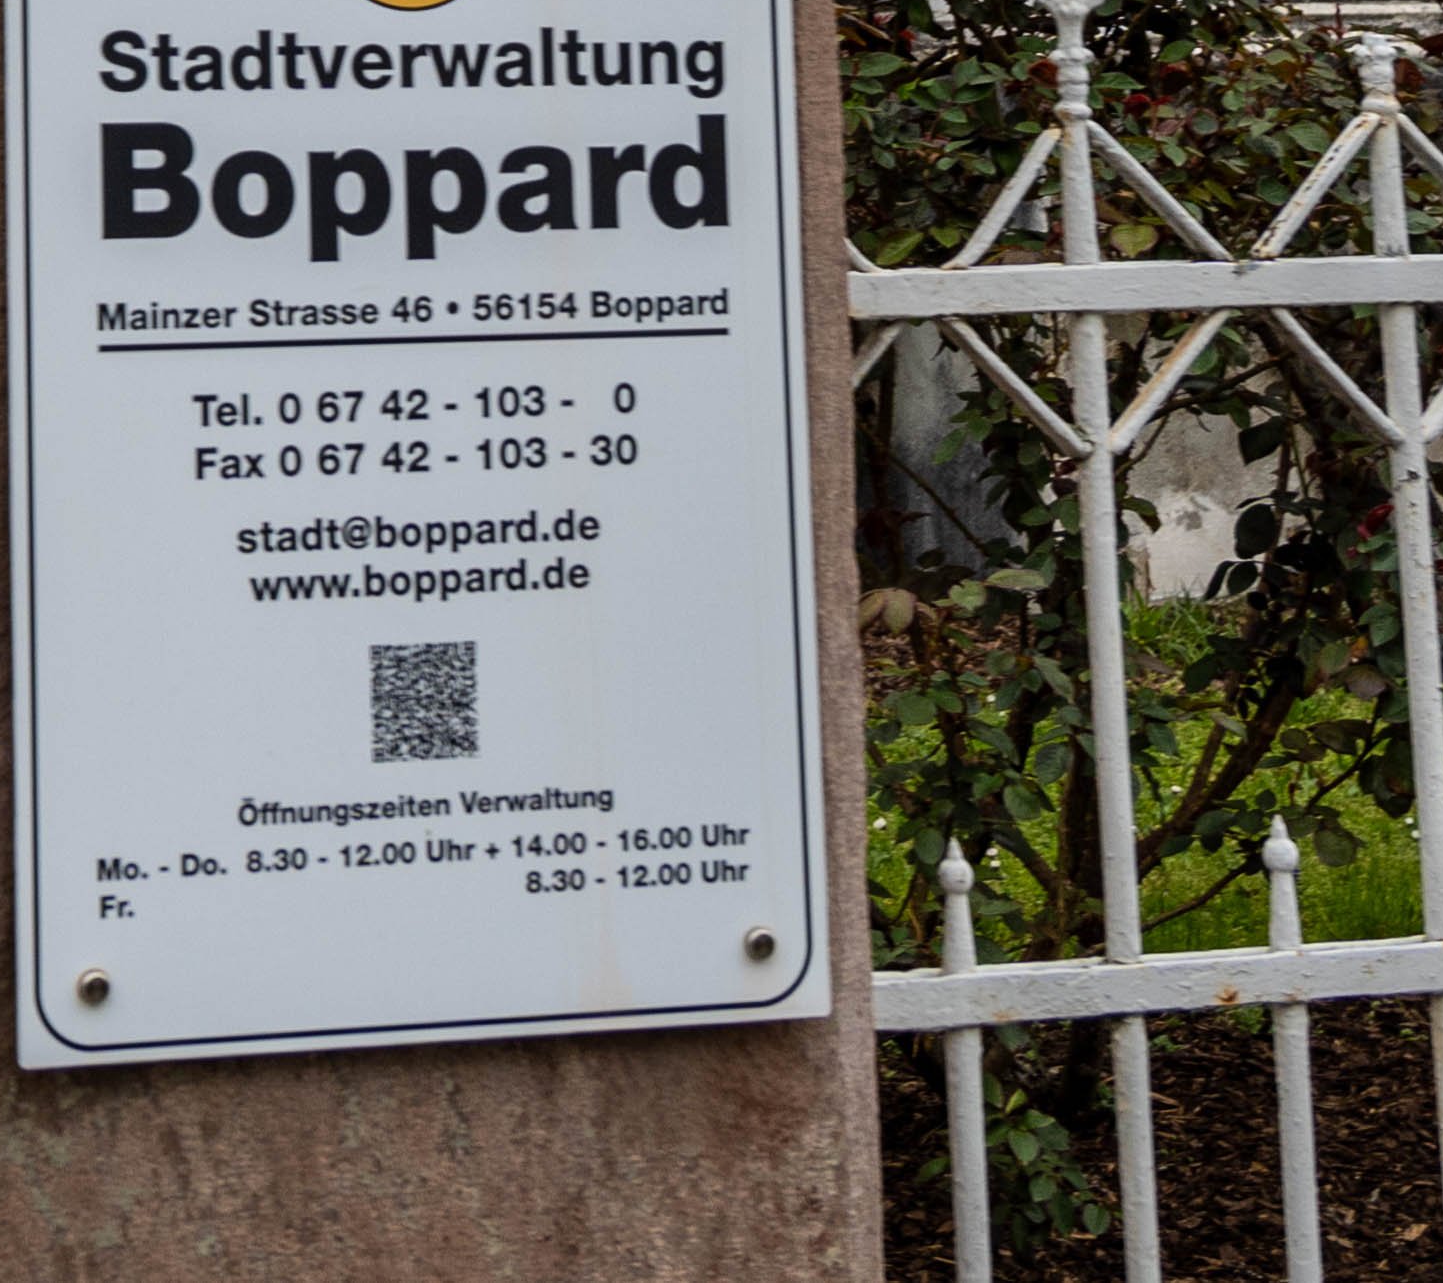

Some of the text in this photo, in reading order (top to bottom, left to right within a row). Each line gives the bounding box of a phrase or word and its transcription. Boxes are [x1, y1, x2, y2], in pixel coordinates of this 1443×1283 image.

[99, 26, 725, 99] Stadtverwaltung
[100, 113, 730, 263] Boppard
[98, 302, 237, 331] Mainzer
[249, 298, 379, 328] Strasse
[391, 295, 433, 323] 46
[473, 292, 578, 322] 56154
[591, 287, 729, 323] Boppard
[192, 393, 262, 427] Tel.
[278, 392, 302, 425] 0
[317, 390, 364, 424] 67
[381, 388, 429, 421] 42
[475, 385, 546, 418] 103
[614, 382, 636, 414] 0
[196, 447, 265, 480] Fax
[279, 444, 302, 477] 0
[318, 442, 365, 476] 67
[381, 440, 430, 473] 42
[477, 436, 547, 470] 103
[590, 434, 638, 467] 30
[237, 508, 600, 554] stadt@boppard.de
[249, 556, 590, 603] www.boppard.de
[238, 788, 614, 827] Öffnungszeiten Verwaltung
[97, 857, 148, 881] Mo.
[181, 853, 227, 877] Do.
[246, 847, 308, 873] 8.30
[340, 841, 416, 867] 12.00
[426, 839, 475, 863] Uhr
[512, 832, 587, 858] 14.00
[618, 826, 692, 852] 16.00
[701, 824, 750, 848] Uhr
[100, 895, 134, 919] Fr.
[526, 868, 586, 894] 8.30
[617, 862, 692, 888] 12.00
[701, 860, 749, 884] Uhr
